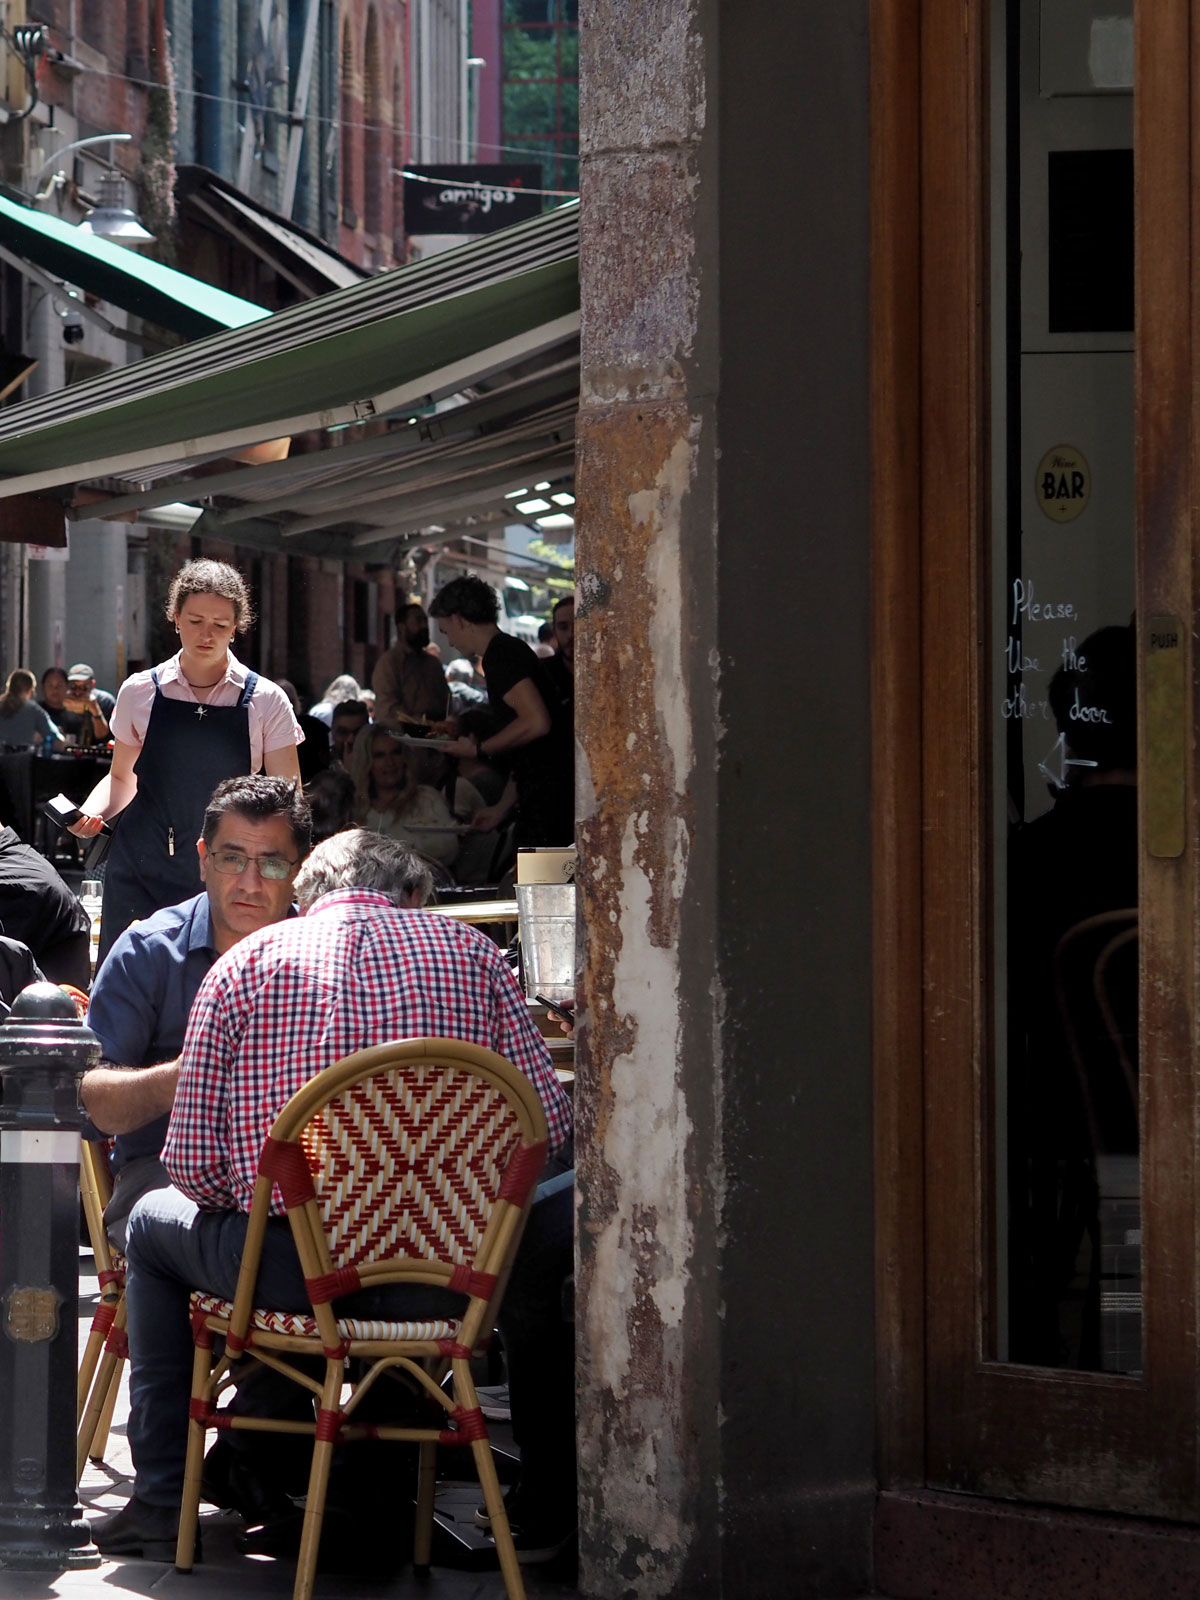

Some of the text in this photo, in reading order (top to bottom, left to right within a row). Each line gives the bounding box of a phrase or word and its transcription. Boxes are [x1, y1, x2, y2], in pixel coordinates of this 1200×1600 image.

[440, 181, 516, 213] amigos
[1042, 471, 1084, 499] BAR
[1012, 577, 1078, 625] Please,
[1005, 635, 1088, 674] Use the
[1152, 632, 1178, 648] PUSH
[1001, 683, 1050, 720] other
